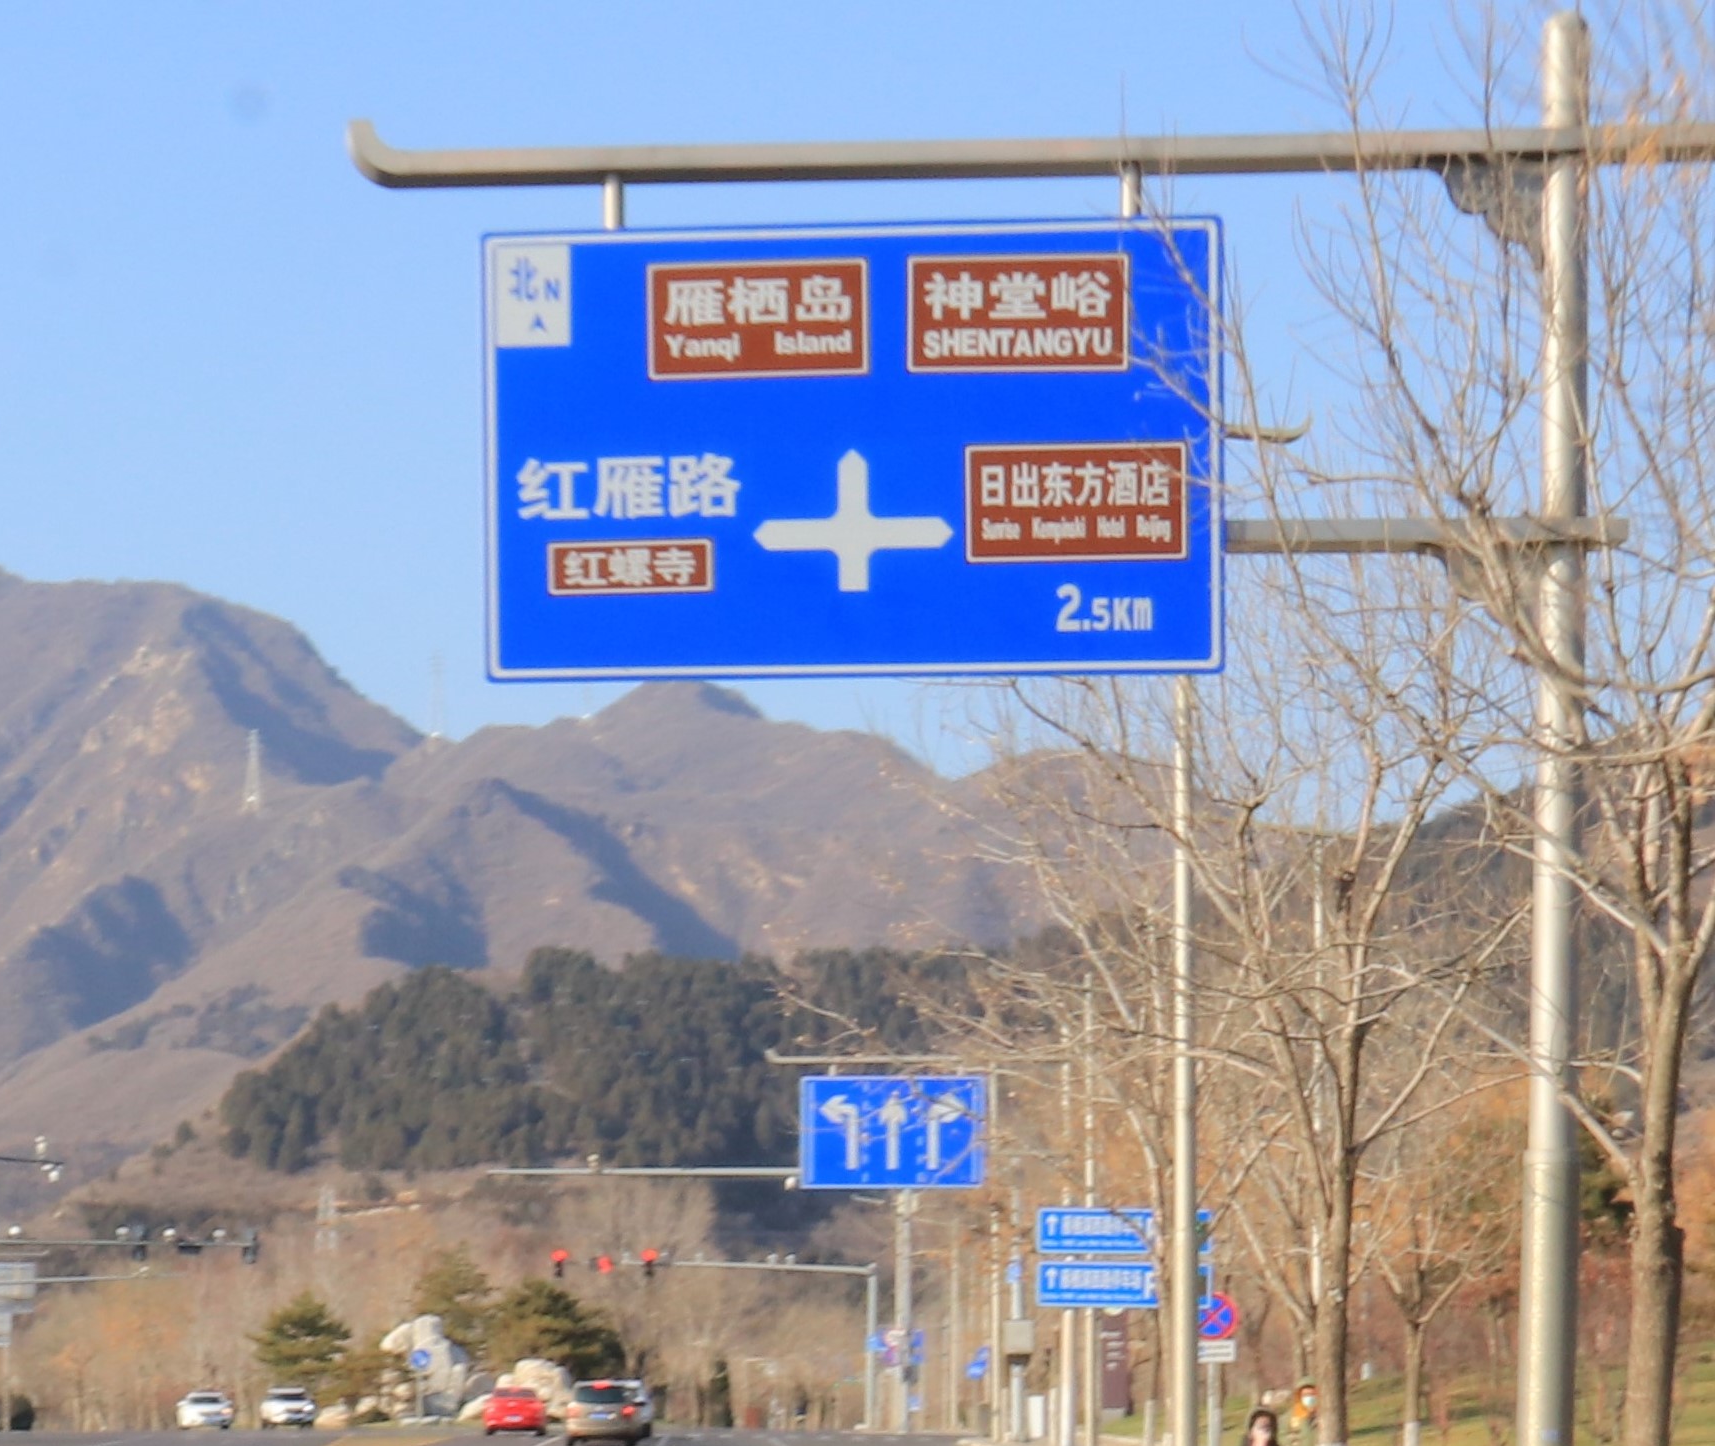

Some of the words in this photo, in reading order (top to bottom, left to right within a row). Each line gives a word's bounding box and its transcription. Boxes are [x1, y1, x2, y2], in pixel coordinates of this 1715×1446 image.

[509, 256, 538, 302] 北
[543, 277, 560, 301] N
[664, 275, 852, 327] 雁栖岛
[923, 271, 1112, 321] 神堂峪
[664, 331, 742, 361] Yanqi
[774, 329, 853, 356] Island
[923, 328, 1114, 359] SHENTANGYU
[516, 453, 742, 520] 红雁路
[980, 460, 1171, 508] 日出东方酒店
[563, 547, 697, 586] 红螺寺
